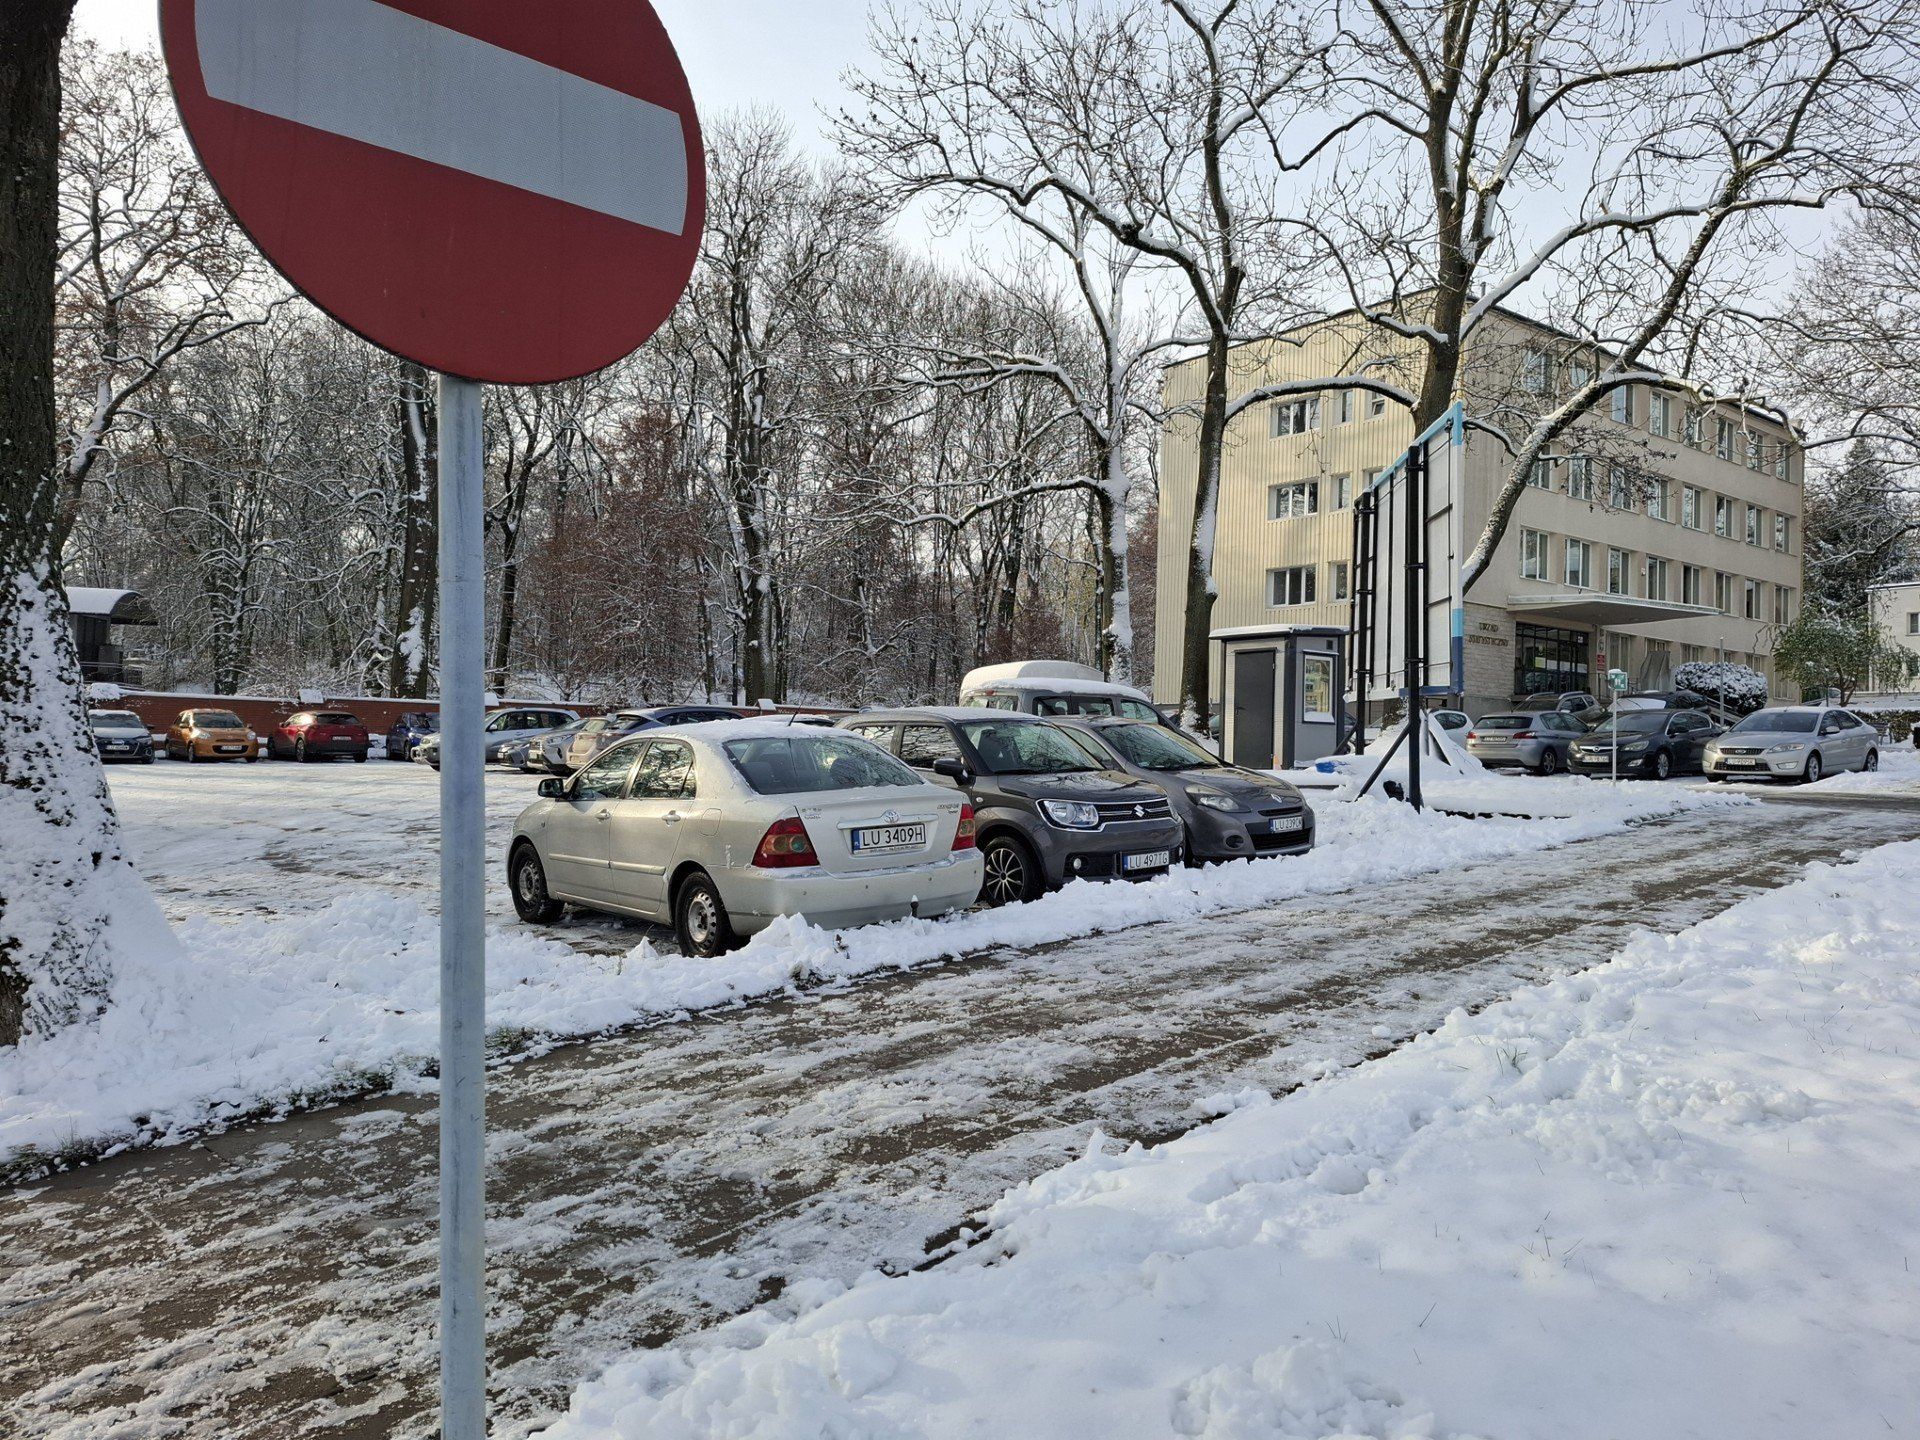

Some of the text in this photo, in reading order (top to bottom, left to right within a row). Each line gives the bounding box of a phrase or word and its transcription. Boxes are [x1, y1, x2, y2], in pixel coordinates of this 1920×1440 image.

[1274, 819, 1285, 830] LU
[862, 827, 923, 846] LU 3409H
[1129, 852, 1168, 868] LU 497TG
